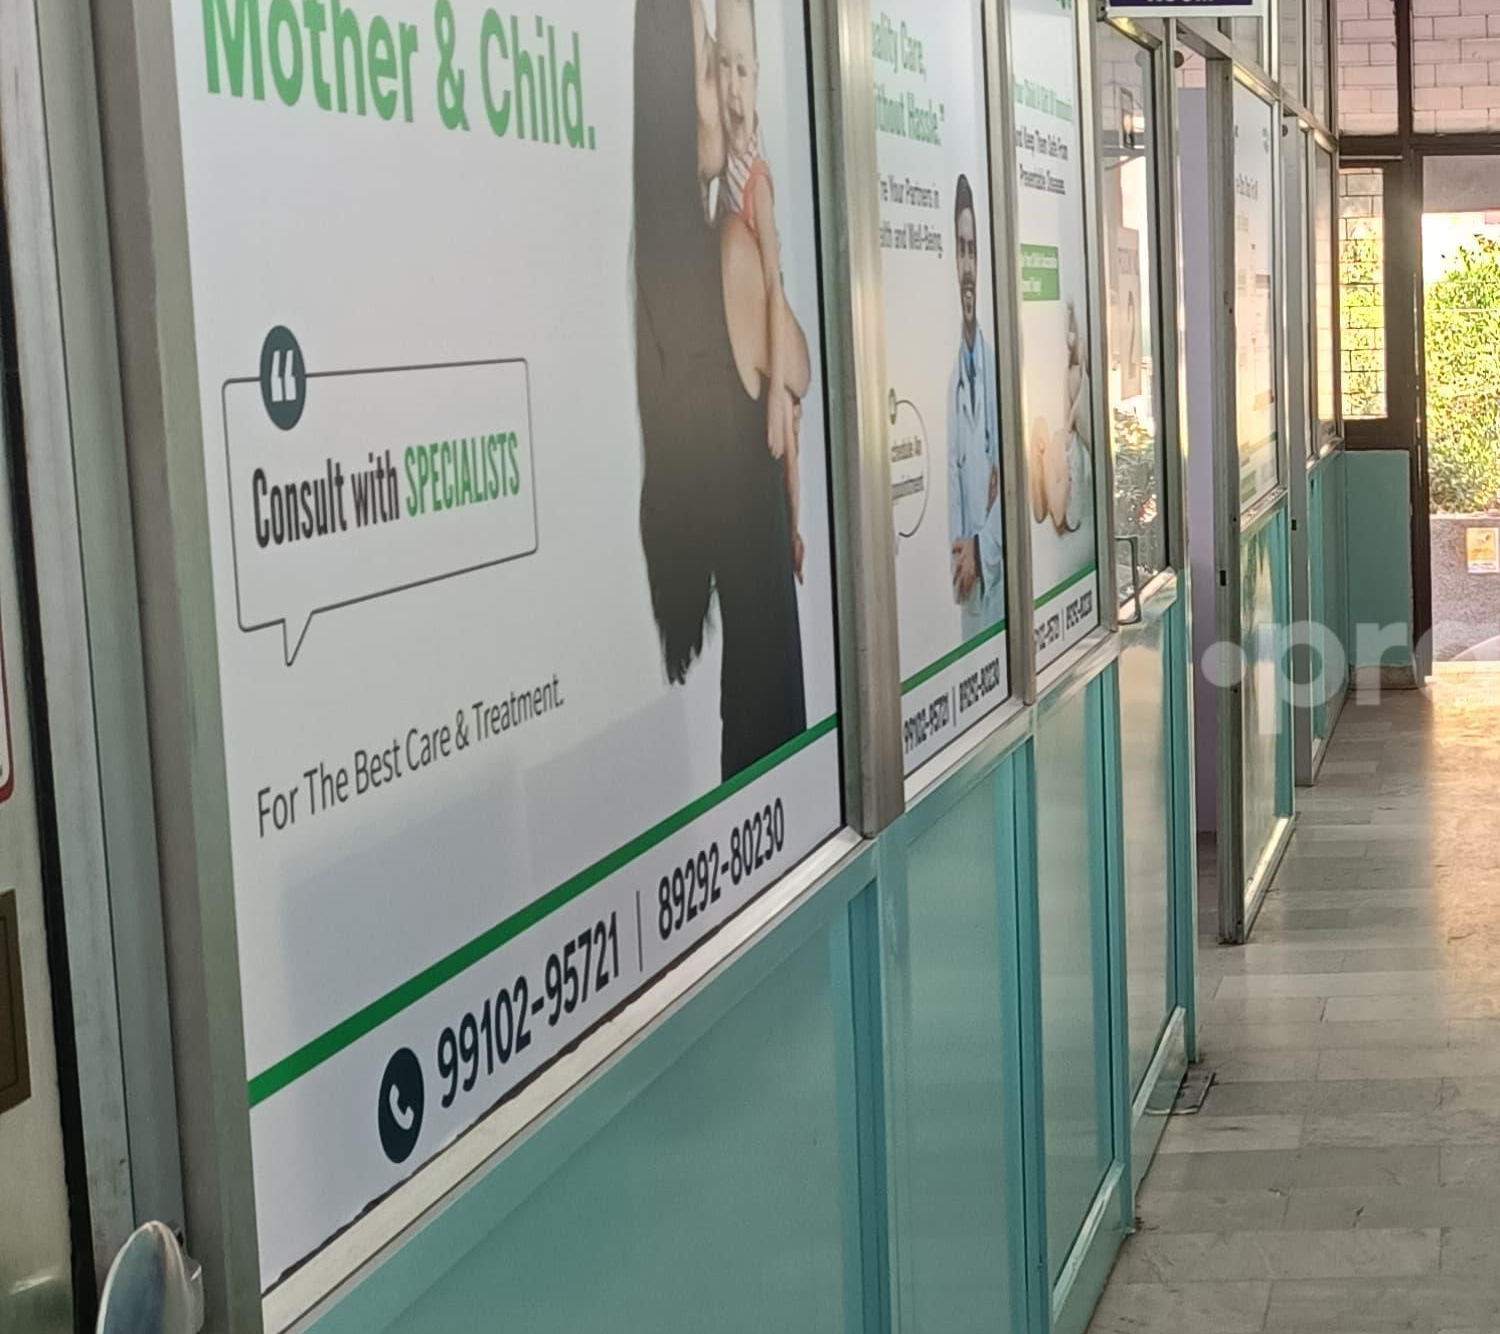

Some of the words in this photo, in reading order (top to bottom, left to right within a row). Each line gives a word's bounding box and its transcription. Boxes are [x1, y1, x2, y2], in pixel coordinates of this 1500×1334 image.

[479, 7, 597, 150] Child.
[872, 11, 898, 73] uality
[250, 457, 348, 550] Consult
[351, 453, 401, 531] with
[404, 429, 520, 524] SPECIALISTS
[257, 783, 298, 838] For
[302, 760, 349, 825] The
[353, 737, 401, 804] Best
[406, 722, 451, 778] Care
[455, 711, 469, 750] &
[472, 673, 565, 743] Treatment.
[437, 910, 621, 1111] 99102-95721
[656, 795, 786, 941] 89292-80230
